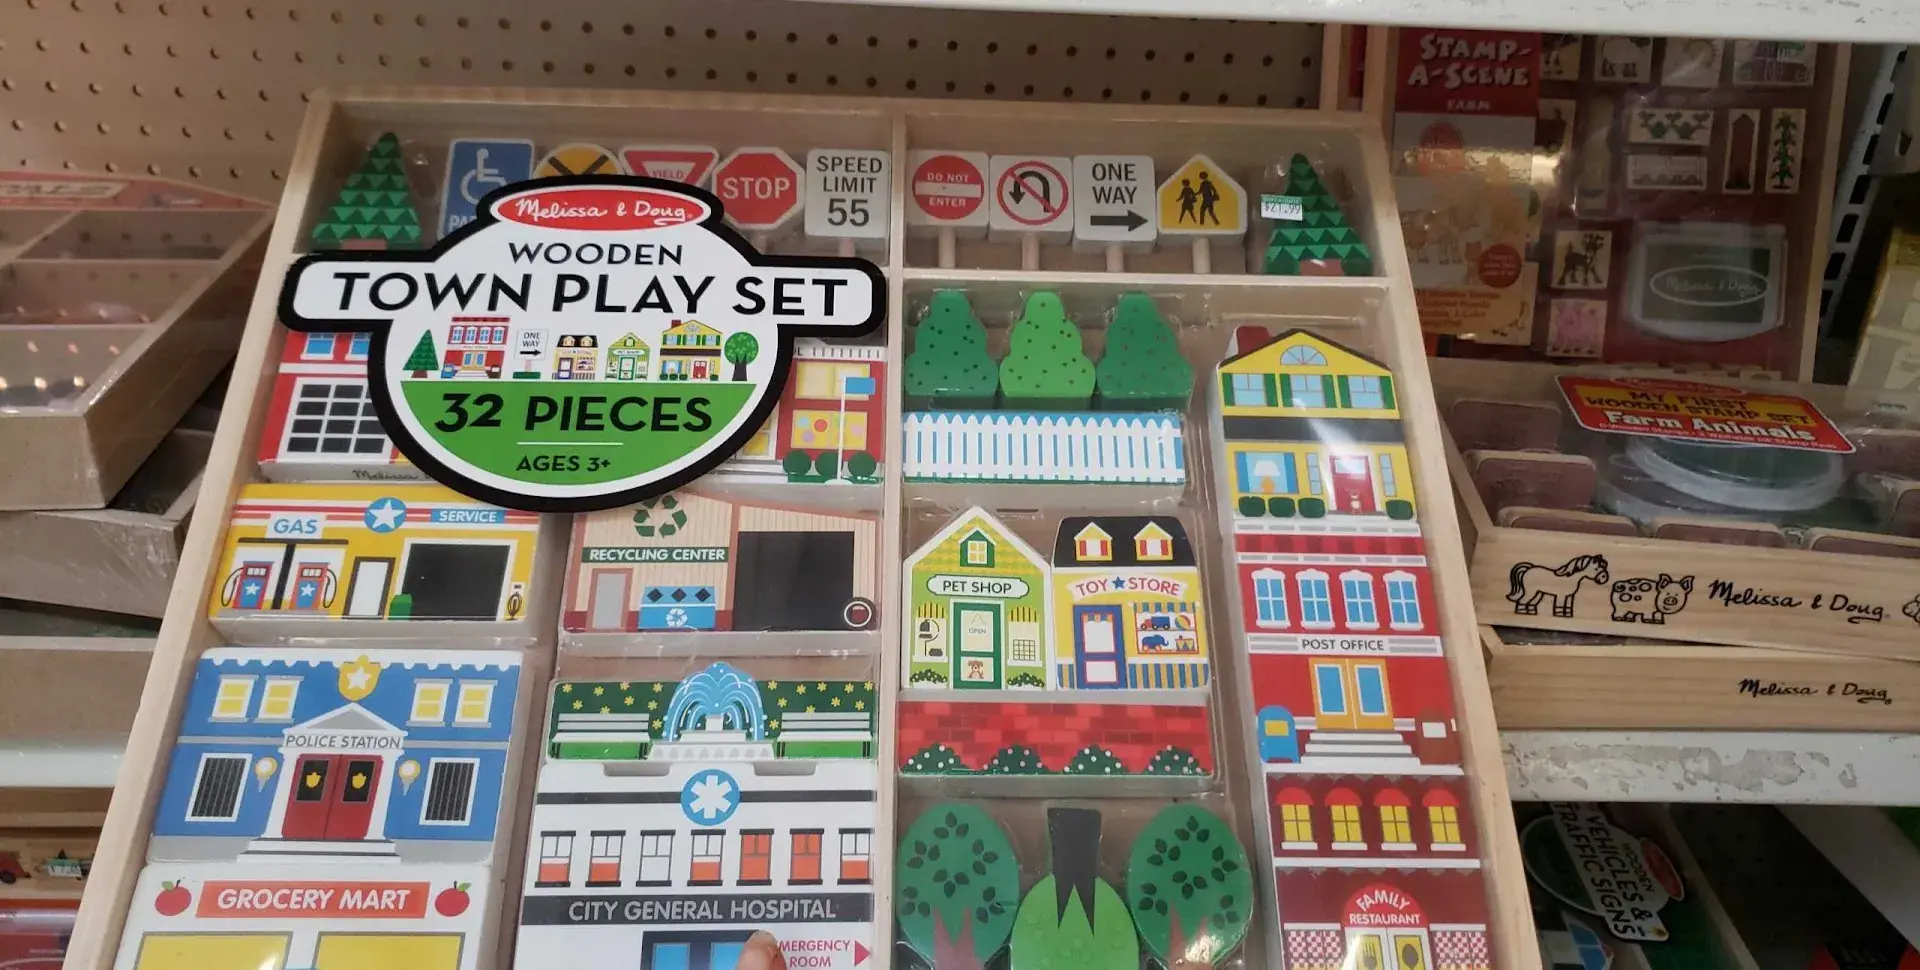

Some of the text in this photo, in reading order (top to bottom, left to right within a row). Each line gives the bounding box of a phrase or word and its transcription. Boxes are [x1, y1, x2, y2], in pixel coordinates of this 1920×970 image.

[1407, 62, 1530, 89] A-SCENE
[652, 168, 684, 179] YIELD
[816, 155, 883, 173] SPEED
[1092, 163, 1136, 182] ONE
[822, 177, 877, 193] LIMIT
[927, 172, 969, 183] DO NOT
[722, 177, 790, 199] STOP
[1092, 186, 1138, 205] WAY
[515, 199, 608, 221] Melissa
[616, 200, 628, 215] &
[929, 197, 966, 207] ENTER
[827, 198, 870, 227] 55
[509, 242, 683, 266] WOODEN
[333, 271, 848, 317] TOWN PLAY SET
[523, 332, 541, 340] ONE
[1628, 391, 1748, 410] MY FIRST
[434, 393, 712, 433] 32 PIECES
[1585, 397, 1808, 424] WOODEN STAMP SET
[1603, 410, 1816, 441] Farm Animals
[516, 455, 610, 472] AGES 3+
[438, 509, 496, 523] SERVICE
[272, 518, 318, 534] GAS
[590, 548, 726, 561] RECYCLING CENTER
[943, 580, 1012, 594] PET SHOP
[1076, 577, 1181, 596] TOY STORE
[1709, 579, 1802, 607] Melissa
[1811, 594, 1823, 609] &
[1302, 639, 1384, 651] POST OFFICE
[1738, 678, 1818, 698] Melissa
[1826, 683, 1836, 695] &
[285, 735, 401, 749] POLICE STATION
[1585, 815, 1653, 921] VEHICLES &
[217, 888, 411, 910] GROCERY MART
[1356, 890, 1410, 912] FAMILY
[1591, 875, 1637, 938] SIGNS
[568, 899, 836, 921] CITY GENERAL HOSPITAL
[1349, 913, 1420, 925] RESTAURANT
[776, 940, 850, 952] MERGENCY
[790, 956, 831, 967] ROOM
